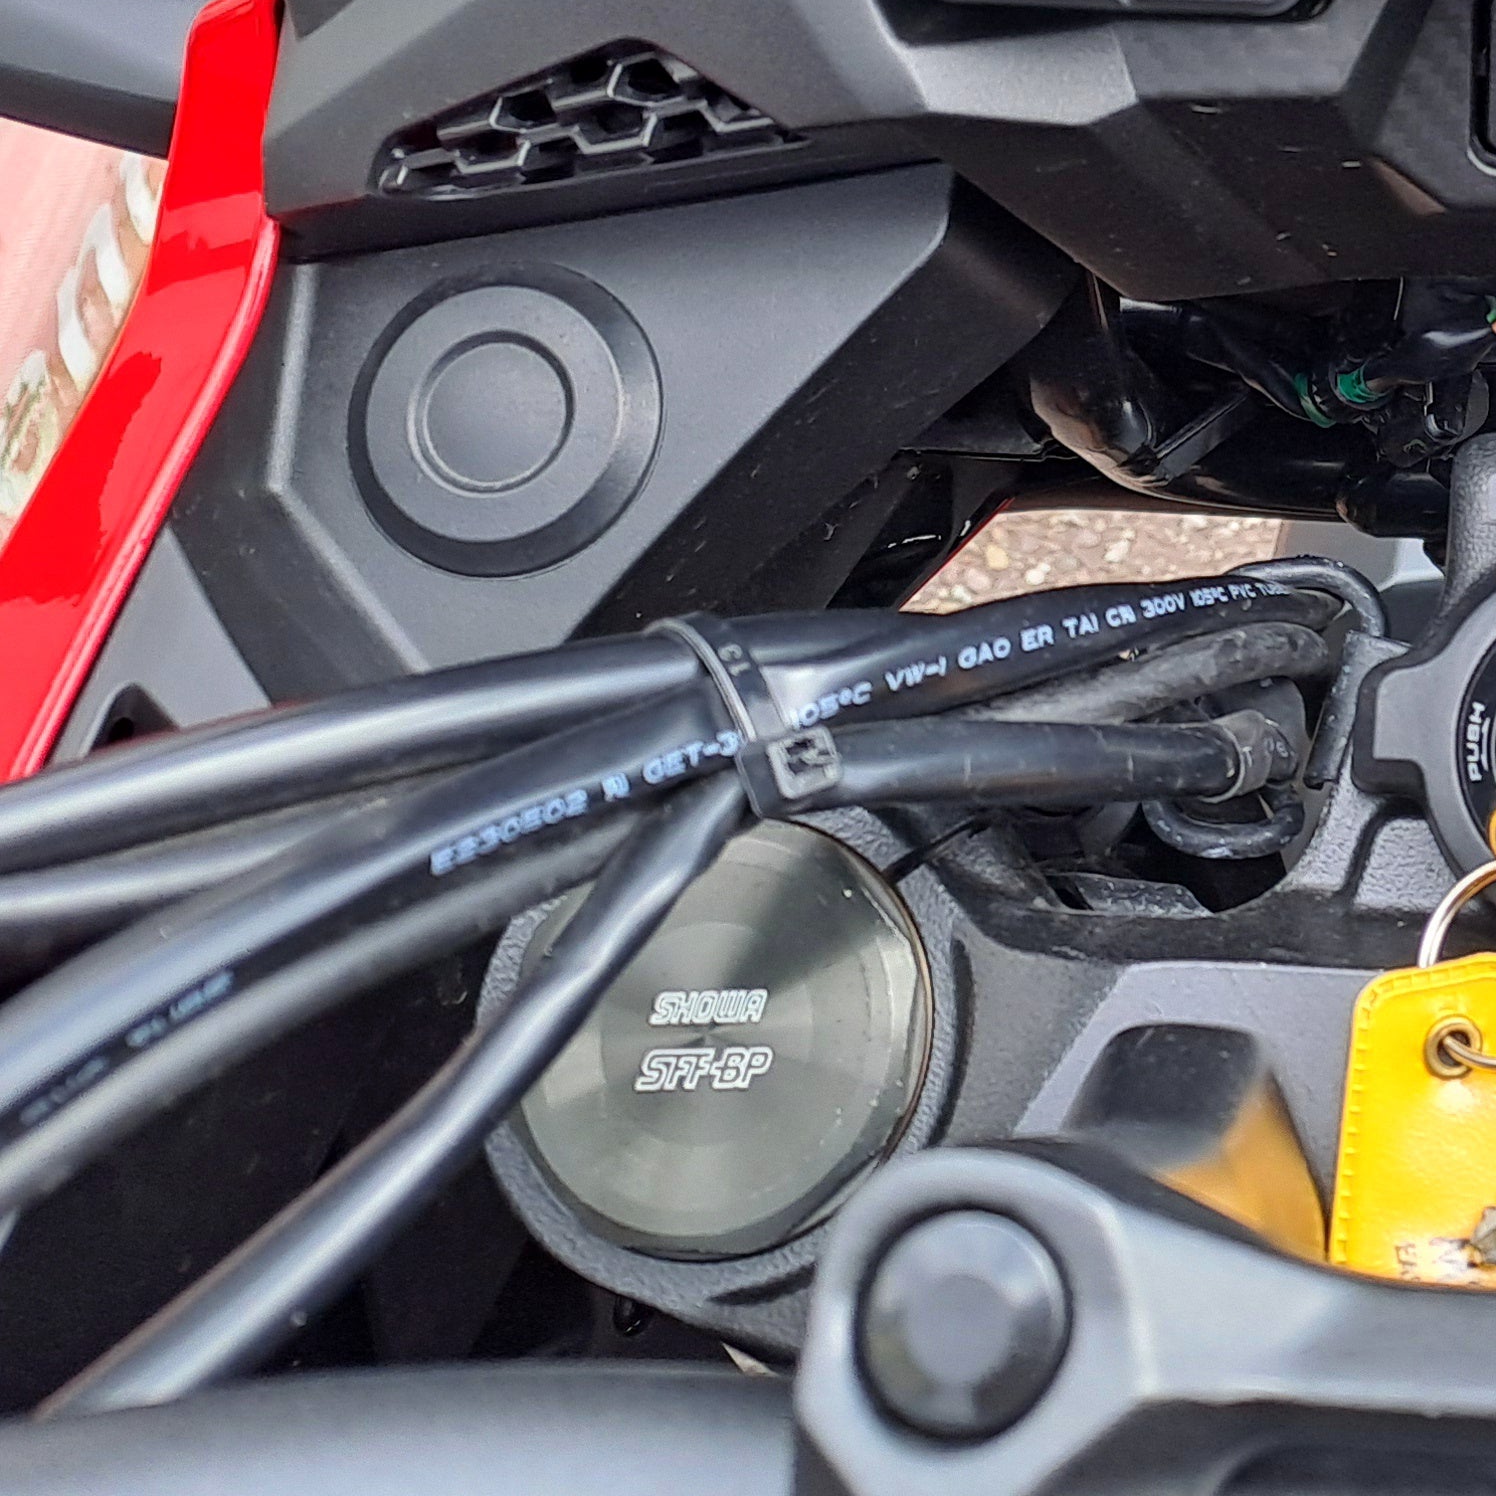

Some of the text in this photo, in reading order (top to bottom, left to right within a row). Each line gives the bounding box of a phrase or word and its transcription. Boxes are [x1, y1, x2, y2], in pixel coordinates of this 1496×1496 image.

[1020, 624, 1054, 652] ER
[1062, 613, 1099, 639] TAI
[1140, 592, 1186, 619] 300V
[1467, 701, 1486, 783] PUSH
[649, 989, 768, 1025] SHOWA
[634, 1046, 773, 1092] SFF-BP
